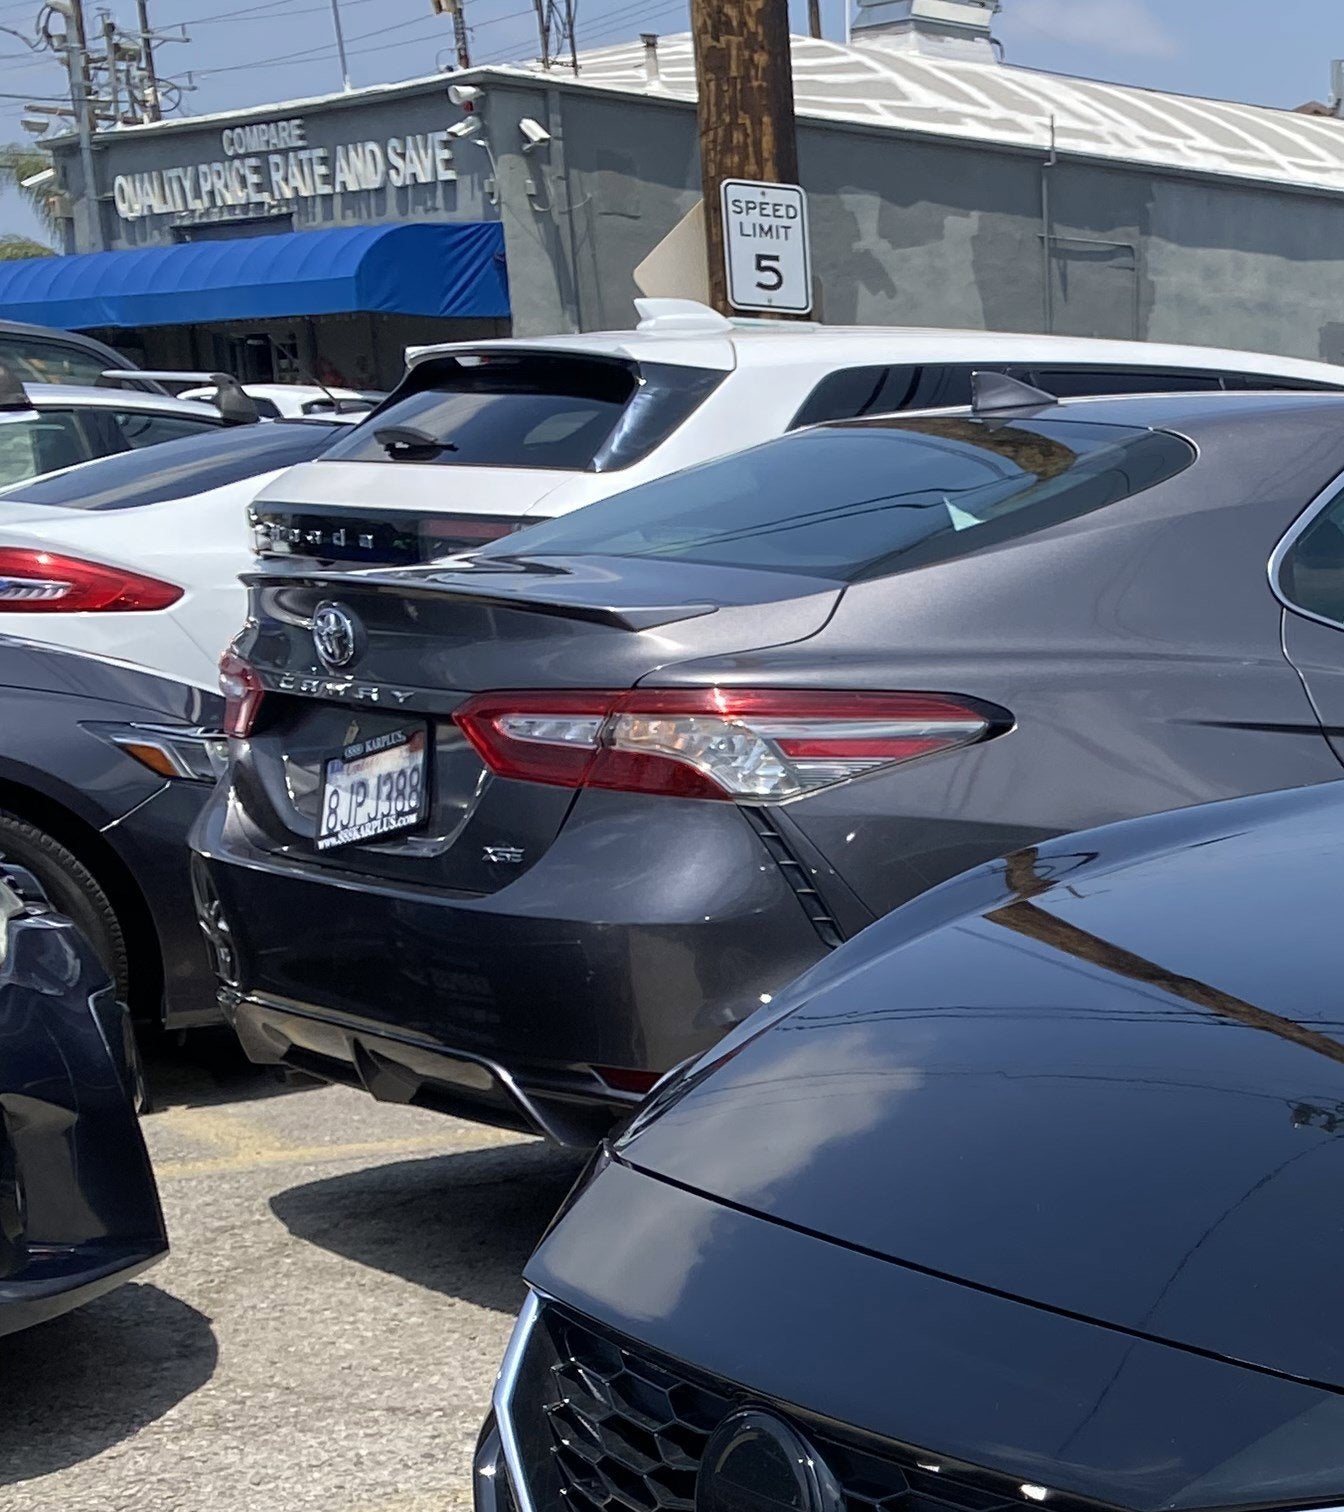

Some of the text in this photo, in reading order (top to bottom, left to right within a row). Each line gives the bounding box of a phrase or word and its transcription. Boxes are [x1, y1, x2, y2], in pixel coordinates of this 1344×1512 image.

[221, 118, 307, 156] COMPARE
[268, 148, 333, 200] RATE
[335, 140, 386, 192] AND
[387, 131, 457, 187] SAVE
[731, 199, 798, 219] SPEED
[739, 221, 792, 241] LIMIT
[754, 253, 783, 291] 5
[279, 675, 415, 703] CAMRY
[326, 765, 420, 834] 8JPJ388
[481, 846, 525, 862] XSE
